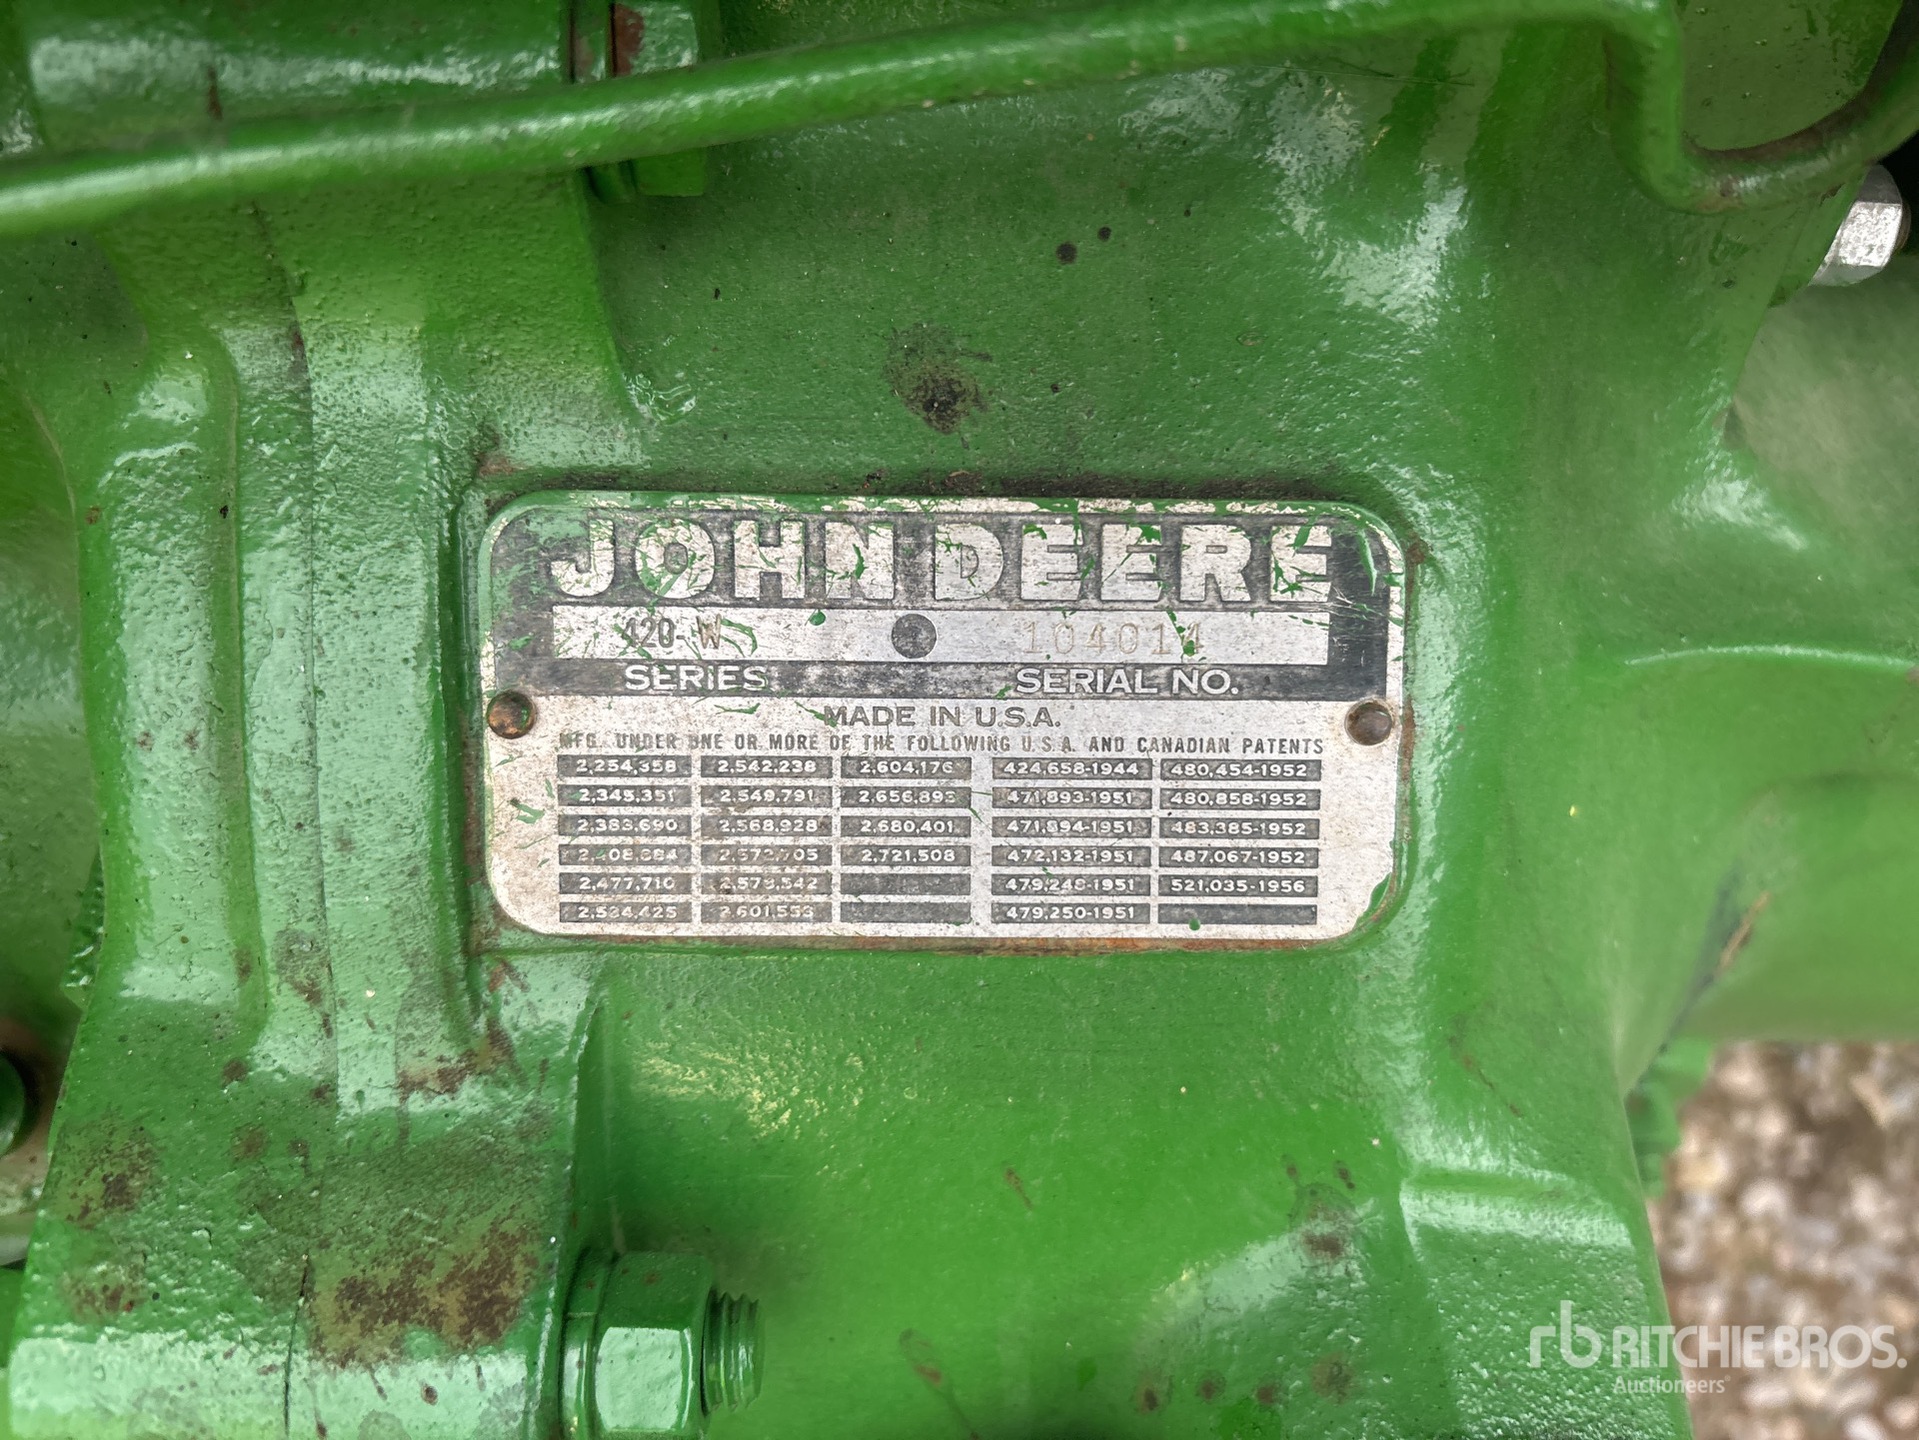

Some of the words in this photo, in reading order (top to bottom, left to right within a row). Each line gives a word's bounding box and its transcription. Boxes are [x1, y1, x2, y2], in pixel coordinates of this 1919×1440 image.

[551, 519, 895, 600] JOHN
[934, 524, 1332, 602] DEERE
[1022, 621, 1204, 655] 104014
[625, 664, 768, 691] SERIES
[1016, 668, 1157, 694] SERIAL
[1172, 669, 1239, 695] NO.
[824, 706, 916, 726] MADE
[930, 706, 960, 726] IN
[976, 707, 1061, 727] U.S.A.
[616, 733, 677, 749] UNDER
[689, 733, 723, 749] ONE
[735, 734, 757, 749] OR
[769, 734, 819, 750] MORE
[864, 735, 894, 751] THE
[908, 735, 1010, 752] FOLLOWING
[1089, 737, 1124, 752] AND
[1137, 737, 1229, 753] CANADIAN
[1243, 739, 1323, 754] PATENTS
[576, 759, 677, 775] 2,254,358
[718, 760, 817, 773] 2,542,238
[860, 761, 953, 774] 2,604,176
[1004, 762, 1138, 775] 424,658-1944
[1171, 764, 1307, 777] 480,454-1952
[579, 789, 676, 803] 2,345,351
[720, 789, 814, 802] 2,549,791
[859, 791, 956, 804] 2,656,893
[1008, 791, 1132, 805] 471,893-1951
[1170, 793, 1307, 806] 480,858-1952
[719, 819, 818, 832] 2,568,928
[861, 820, 953, 834] 2,680,401
[1007, 820, 1132, 834] 471,894-1951
[1172, 822, 1306, 835] 483,385-1952
[861, 850, 955, 863] 2,721,508
[1008, 850, 1133, 863] 472,132-1951
[1171, 850, 1305, 864] 487,067-1952
[579, 877, 675, 891] 2,477,710
[1171, 879, 1305, 893] 521,035-1956
[1006, 907, 1134, 920] 479,250-1951
